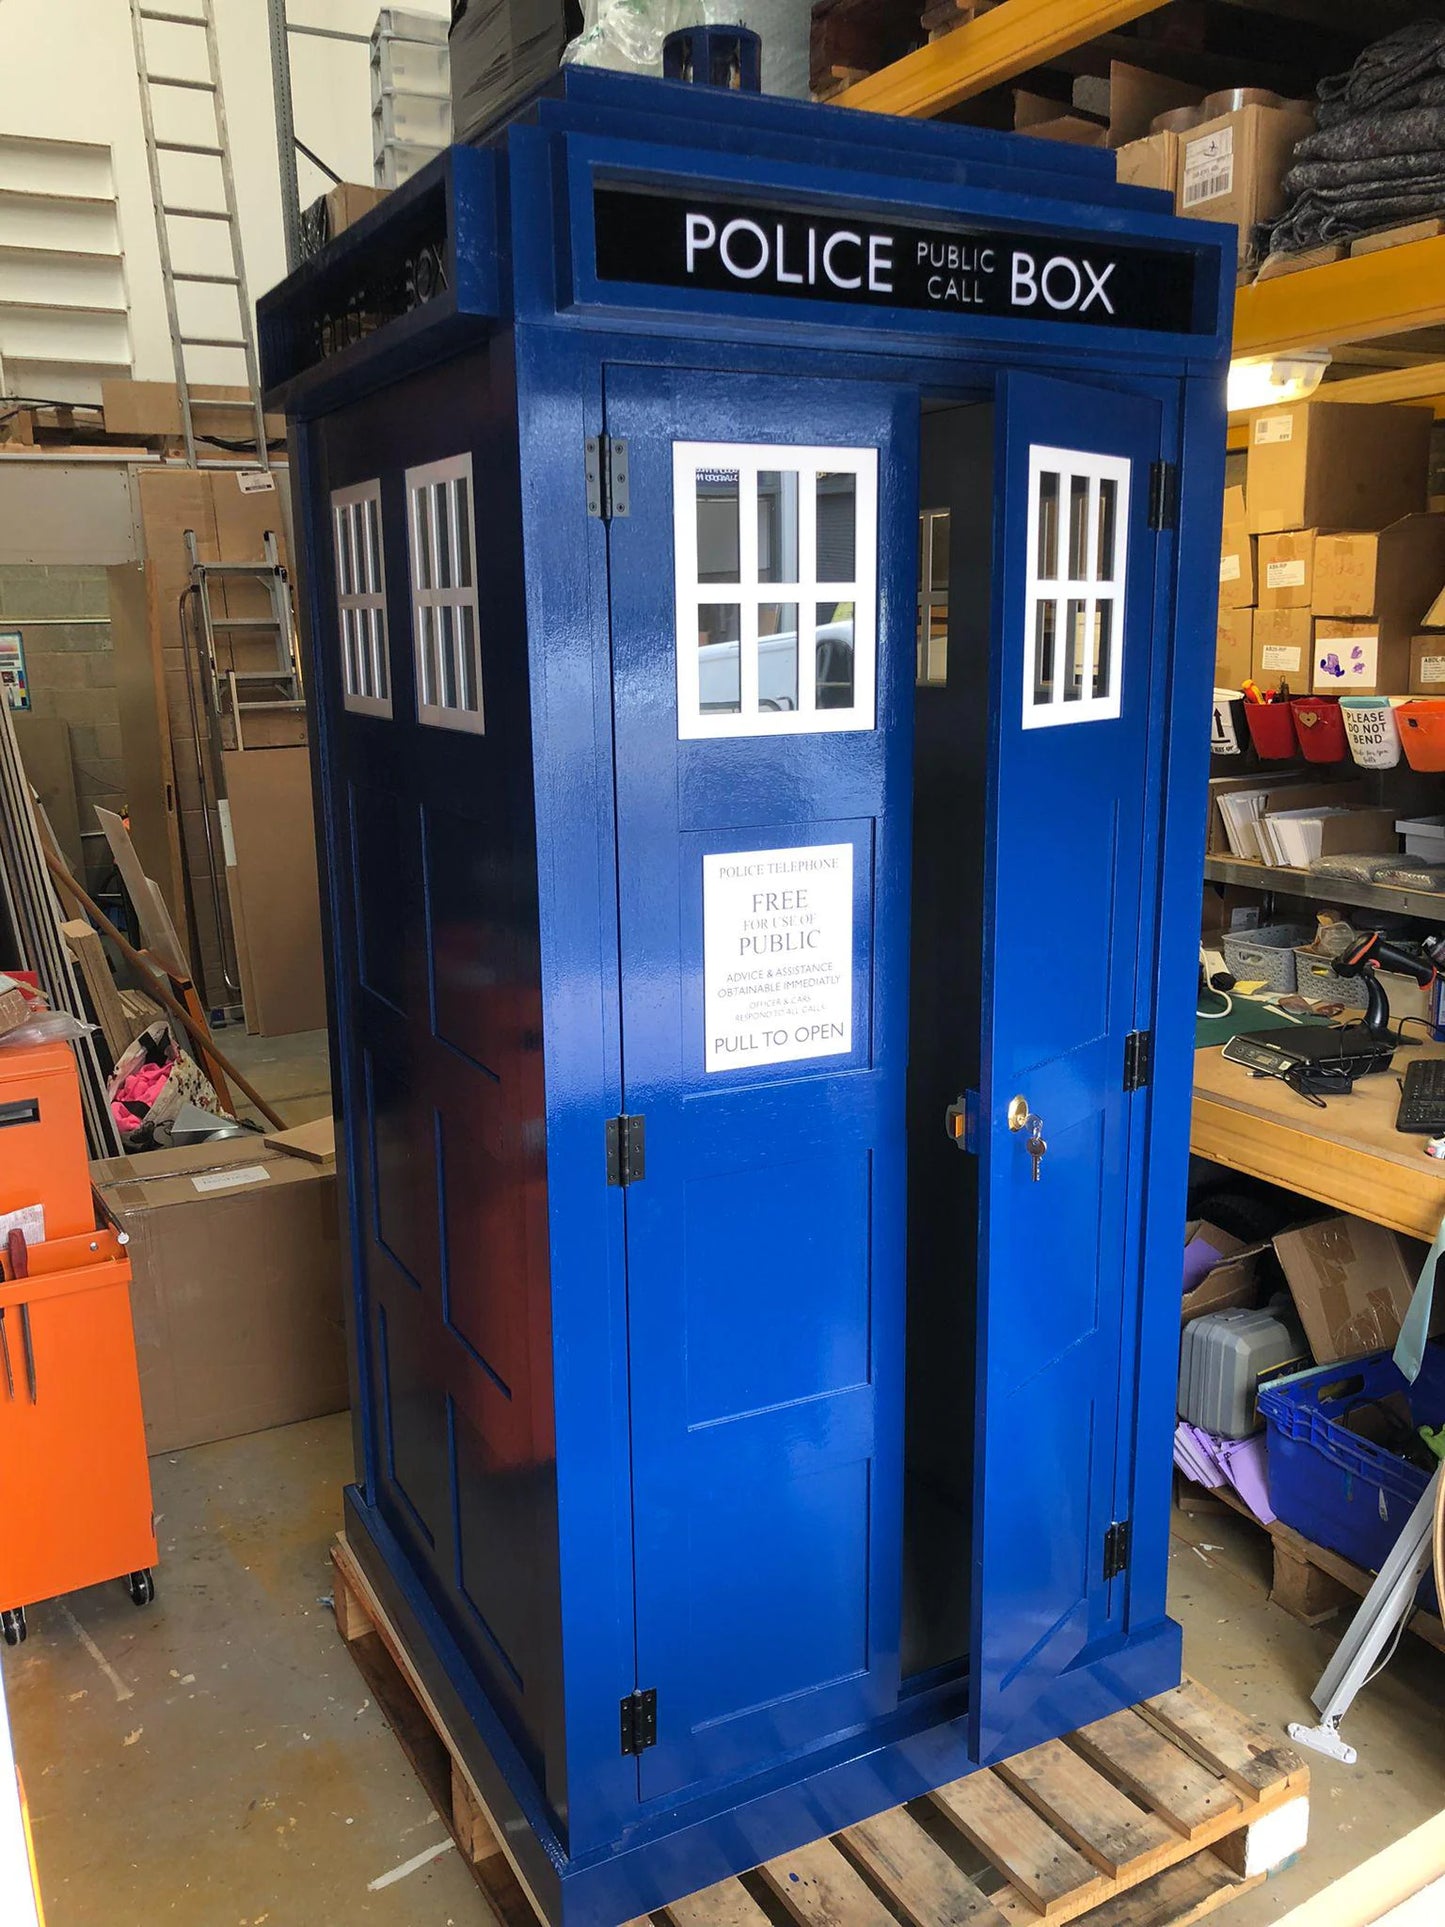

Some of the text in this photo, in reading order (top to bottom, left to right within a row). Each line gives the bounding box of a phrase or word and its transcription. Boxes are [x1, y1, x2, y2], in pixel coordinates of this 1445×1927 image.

[686, 213, 893, 292] POLICE
[917, 241, 994, 273] PUBLIC
[928, 276, 983, 303] CALL
[1011, 252, 1116, 314] BOX
[1347, 711, 1385, 723] PLEASE
[1348, 722, 1386, 733] DO NOT
[1353, 734, 1382, 744] BEND
[719, 857, 839, 879] POLICE TELEPHONE
[752, 889, 808, 913] FREE
[743, 912, 817, 931] FOR USE OF
[739, 929, 821, 956] PUBLIC
[726, 961, 833, 983] ADVICE & ASSISTANCE
[717, 982, 781, 998] OBTAINABLE
[714, 1022, 844, 1054] PULL TO OPEN
